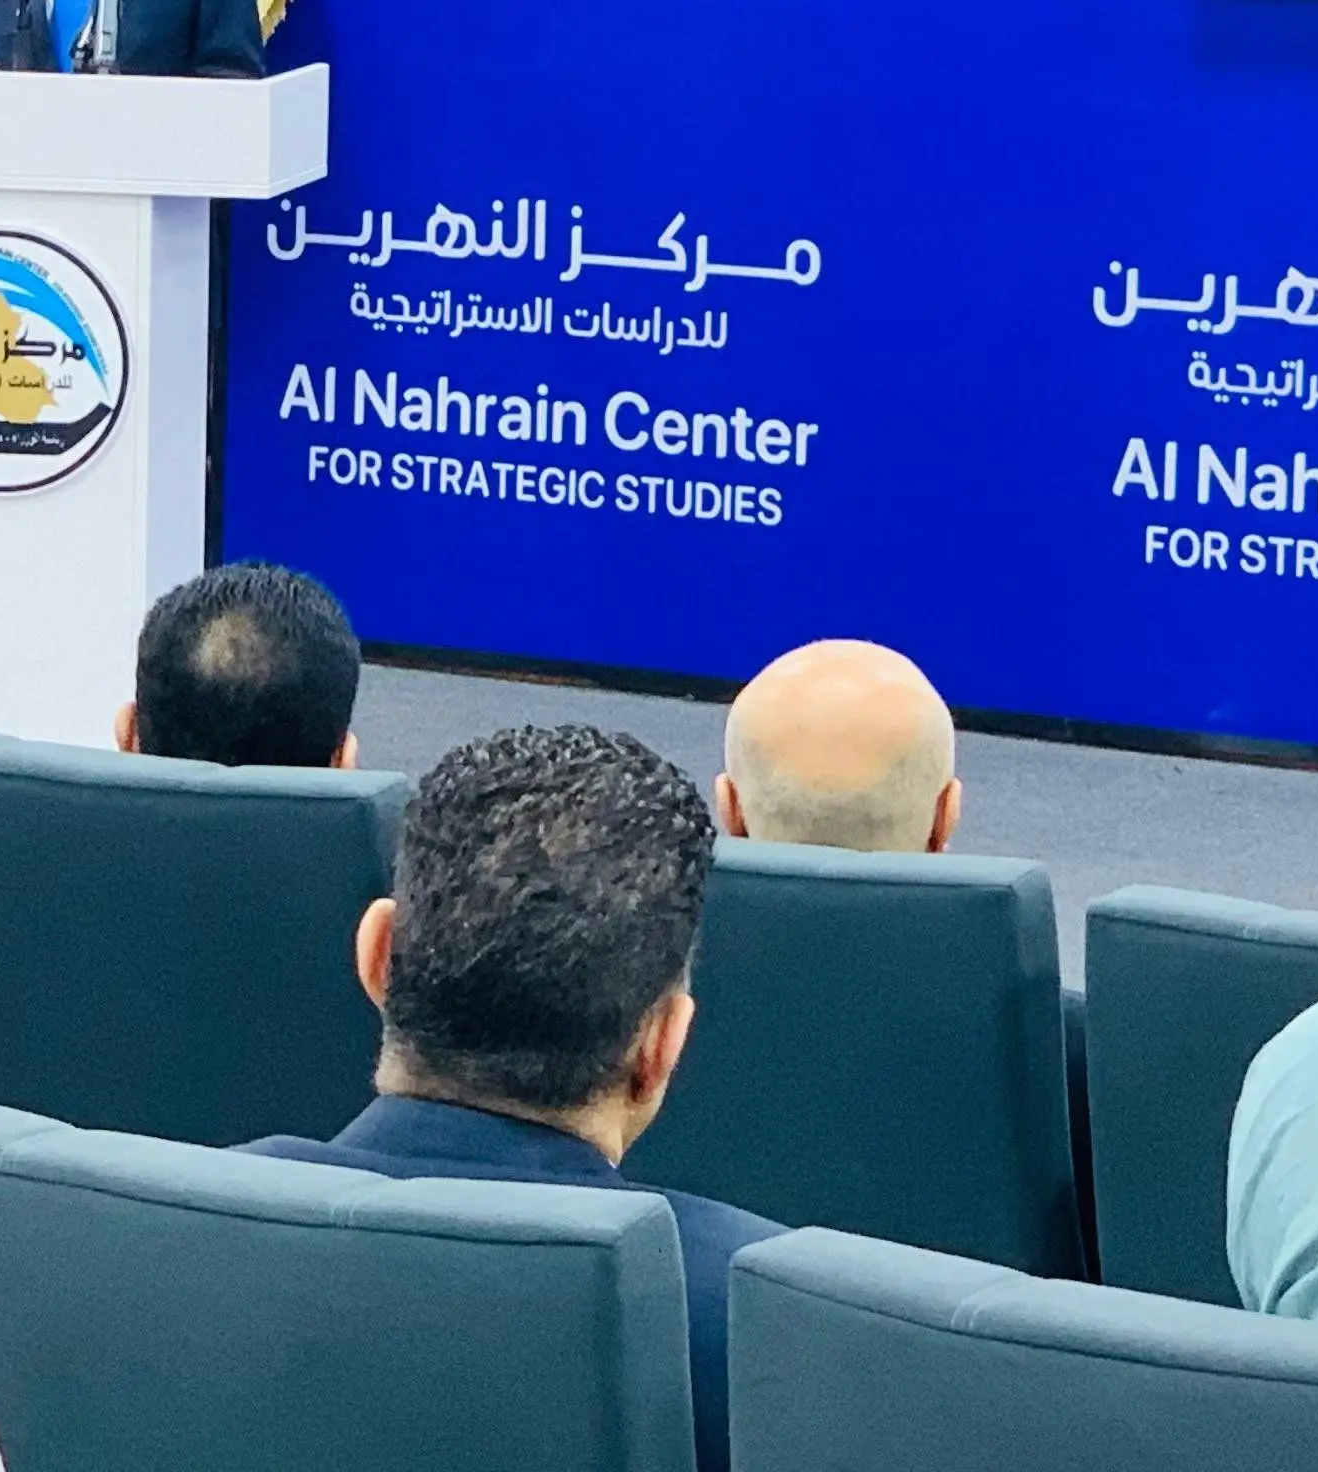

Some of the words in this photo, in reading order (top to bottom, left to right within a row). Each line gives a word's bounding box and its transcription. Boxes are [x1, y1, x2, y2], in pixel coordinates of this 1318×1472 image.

[267, 197, 545, 267] النهرين
[560, 206, 820, 291] مركز
[351, 283, 552, 337] الاستراتيجية
[564, 303, 727, 354] للدراسات
[2, 326, 86, 364] مركز
[280, 364, 335, 422] Al
[355, 370, 586, 445] Nahrain
[605, 392, 818, 465] Center
[309, 446, 381, 486] FOR
[392, 454, 604, 508] STRATEGIC
[616, 475, 781, 525] STUDIES
[1113, 438, 1176, 500] Al
[1146, 526, 1229, 570] FOR
